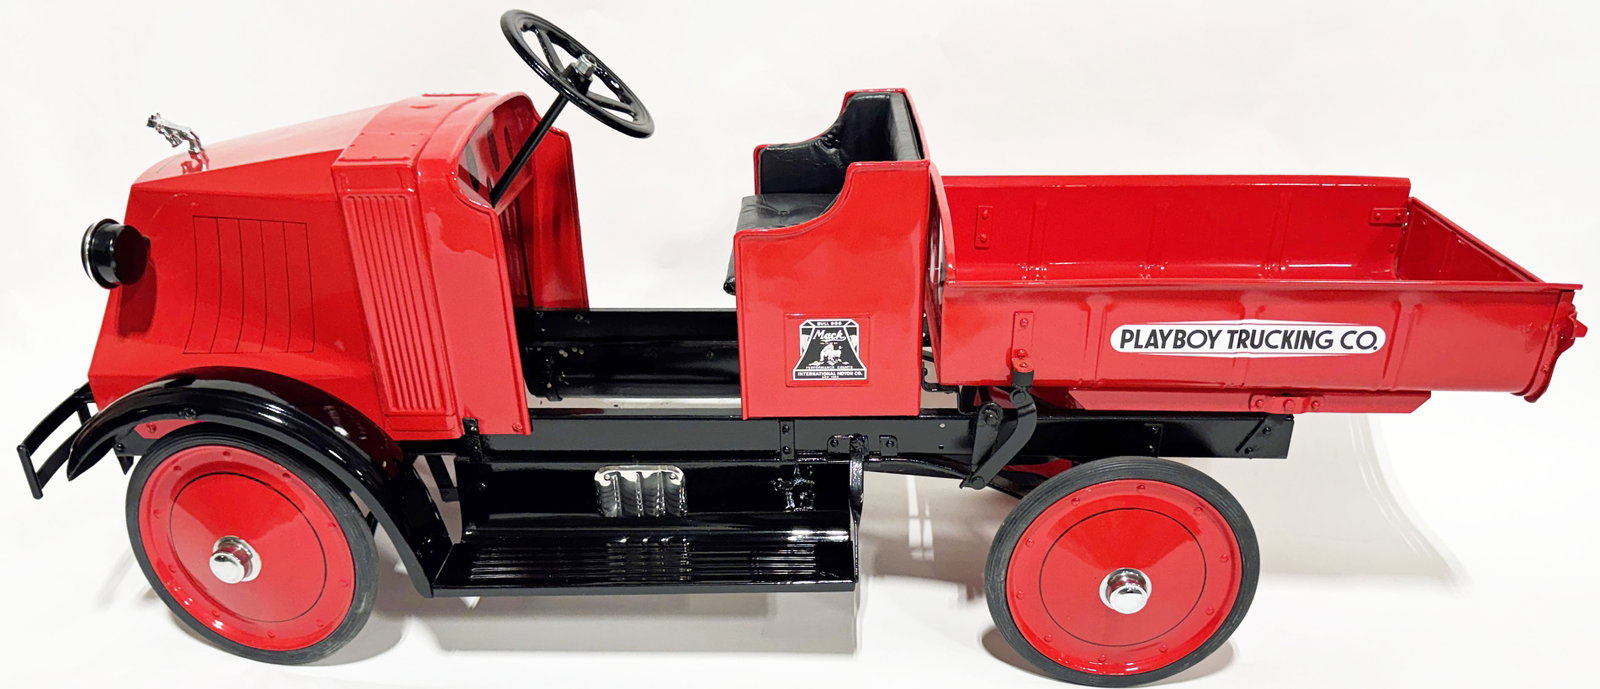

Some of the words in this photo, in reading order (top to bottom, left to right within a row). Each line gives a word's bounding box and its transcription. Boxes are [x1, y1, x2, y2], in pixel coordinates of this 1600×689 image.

[812, 329, 847, 342] Mack
[1120, 329, 1222, 349] PLAYBOY
[1227, 329, 1334, 350] TRUCKING
[1340, 330, 1378, 350] CO.
